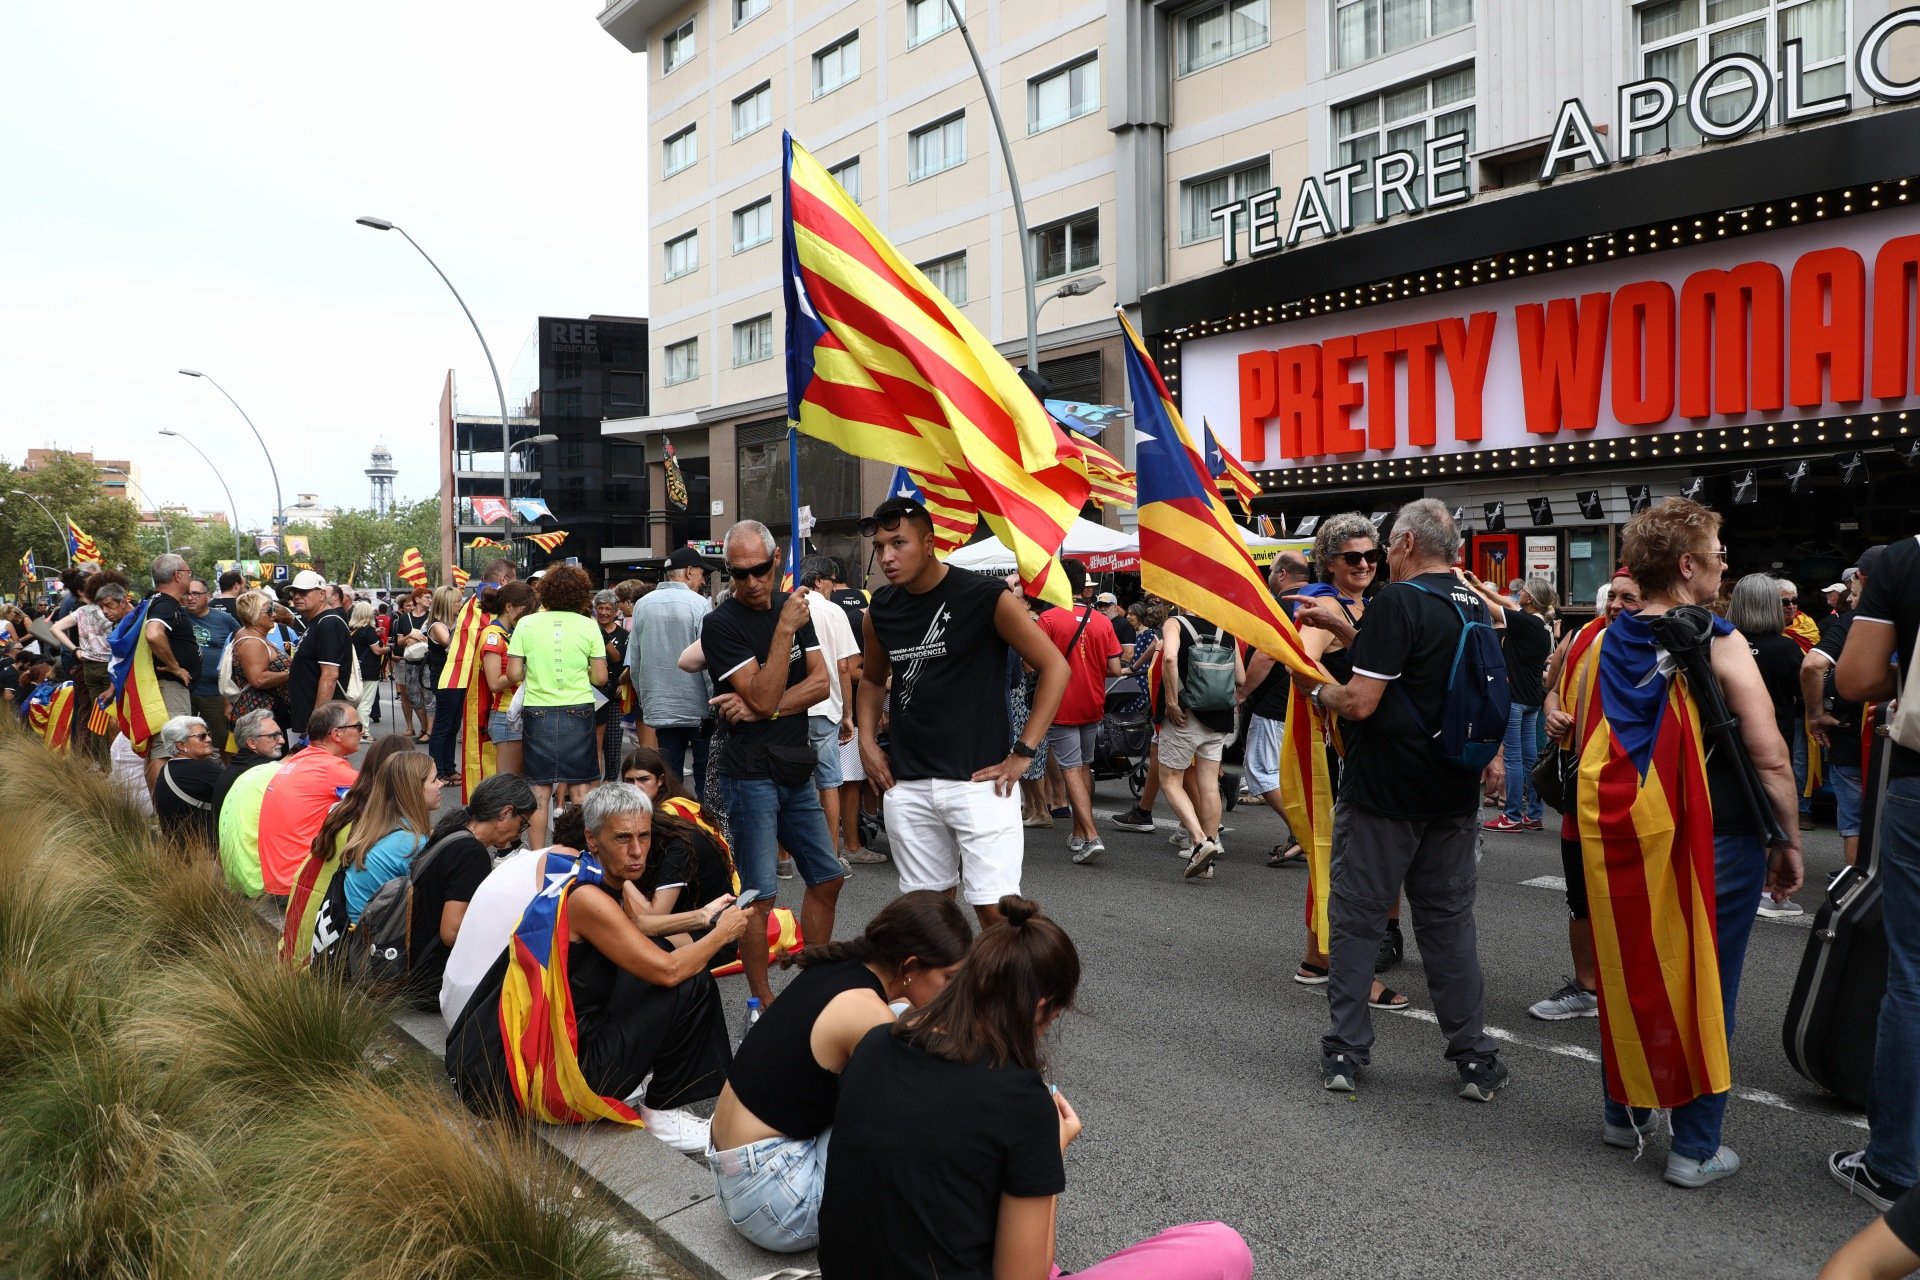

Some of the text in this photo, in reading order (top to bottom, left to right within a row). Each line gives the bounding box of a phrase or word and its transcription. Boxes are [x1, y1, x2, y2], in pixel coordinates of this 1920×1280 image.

[1211, 6, 1920, 265] TEATRE APOLO
[551, 323, 597, 345] REE
[1238, 234, 1920, 462] PRETTY WOMAN
[1252, 551, 1267, 560] anvi
[275, 566, 286, 579] P
[1450, 592, 1479, 605] 11S/10
